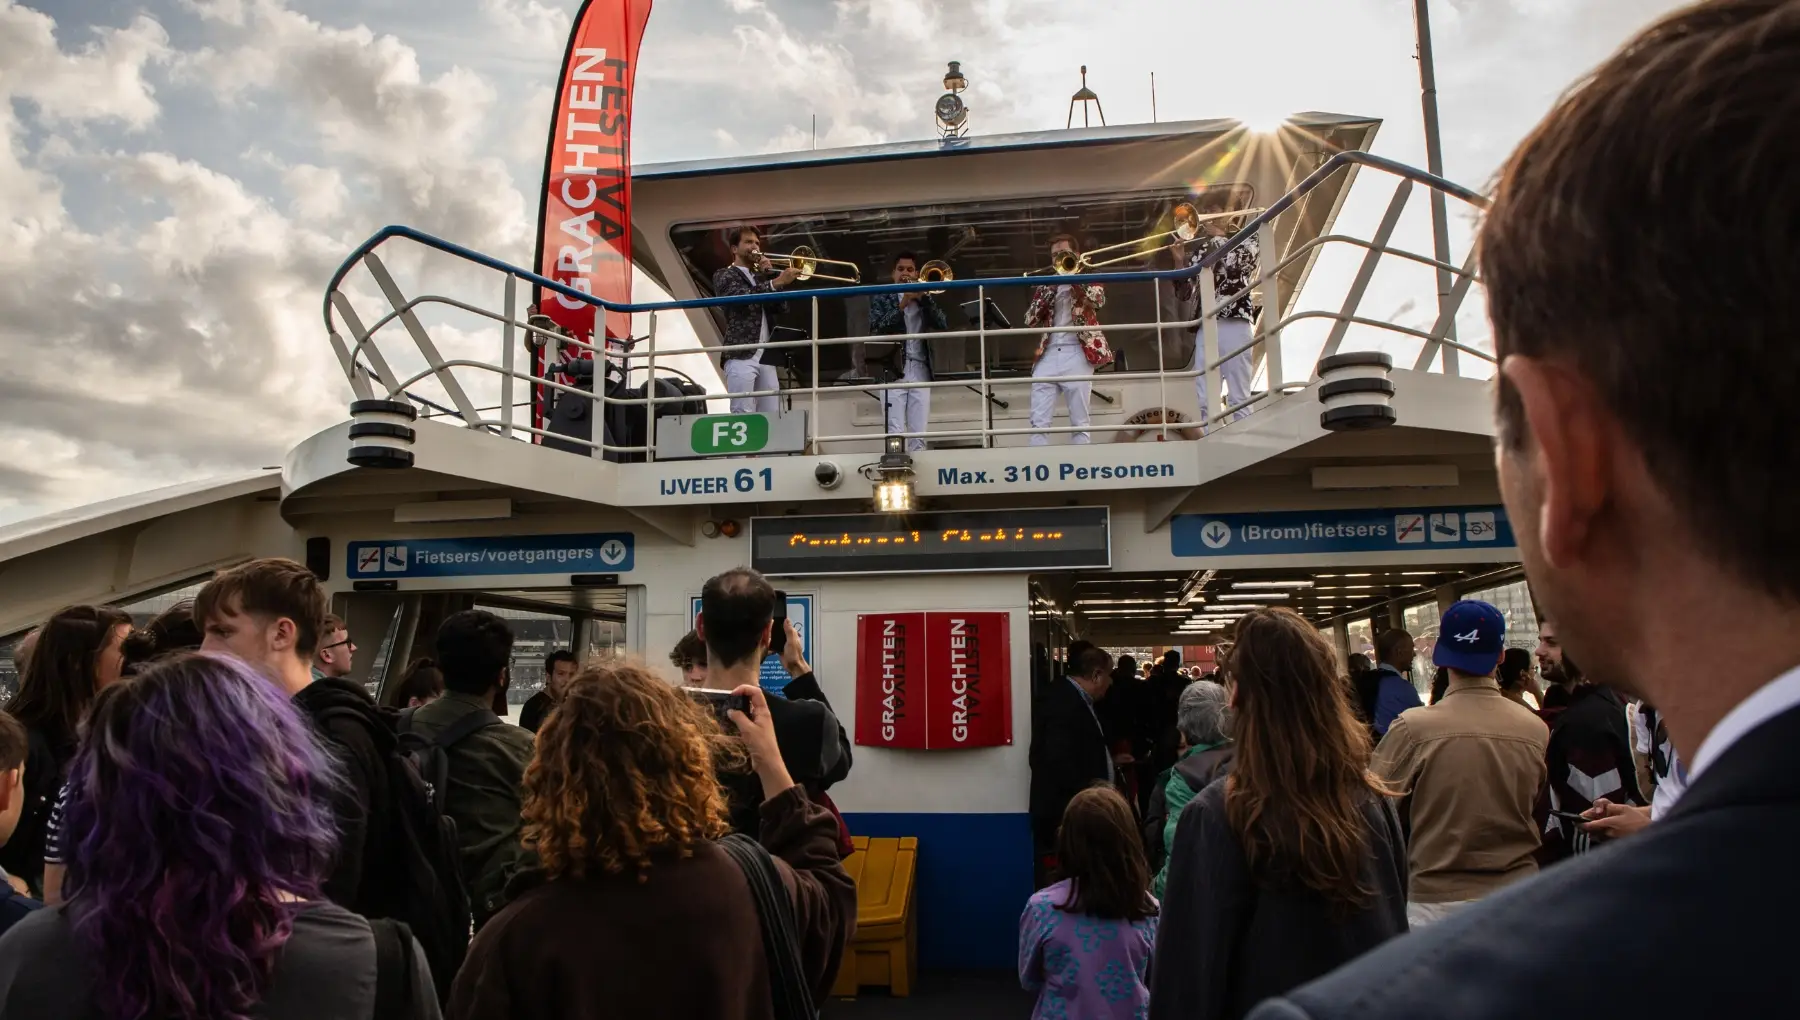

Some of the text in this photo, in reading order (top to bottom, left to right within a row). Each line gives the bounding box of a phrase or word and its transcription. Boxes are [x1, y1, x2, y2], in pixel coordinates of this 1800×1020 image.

[555, 47, 607, 310] GRACHTEN
[711, 421, 748, 447] F3
[660, 467, 772, 495] IJVEER 61
[938, 461, 1174, 485] Max. 310 Personen
[1240, 522, 1388, 542] (Brom)fietsers
[415, 547, 593, 563] Fietsers/voetgangers
[1504, 639, 1537, 648] AERSK
[882, 619, 896, 742] GRACHTEN
[951, 618, 968, 742] GRACHTEN
